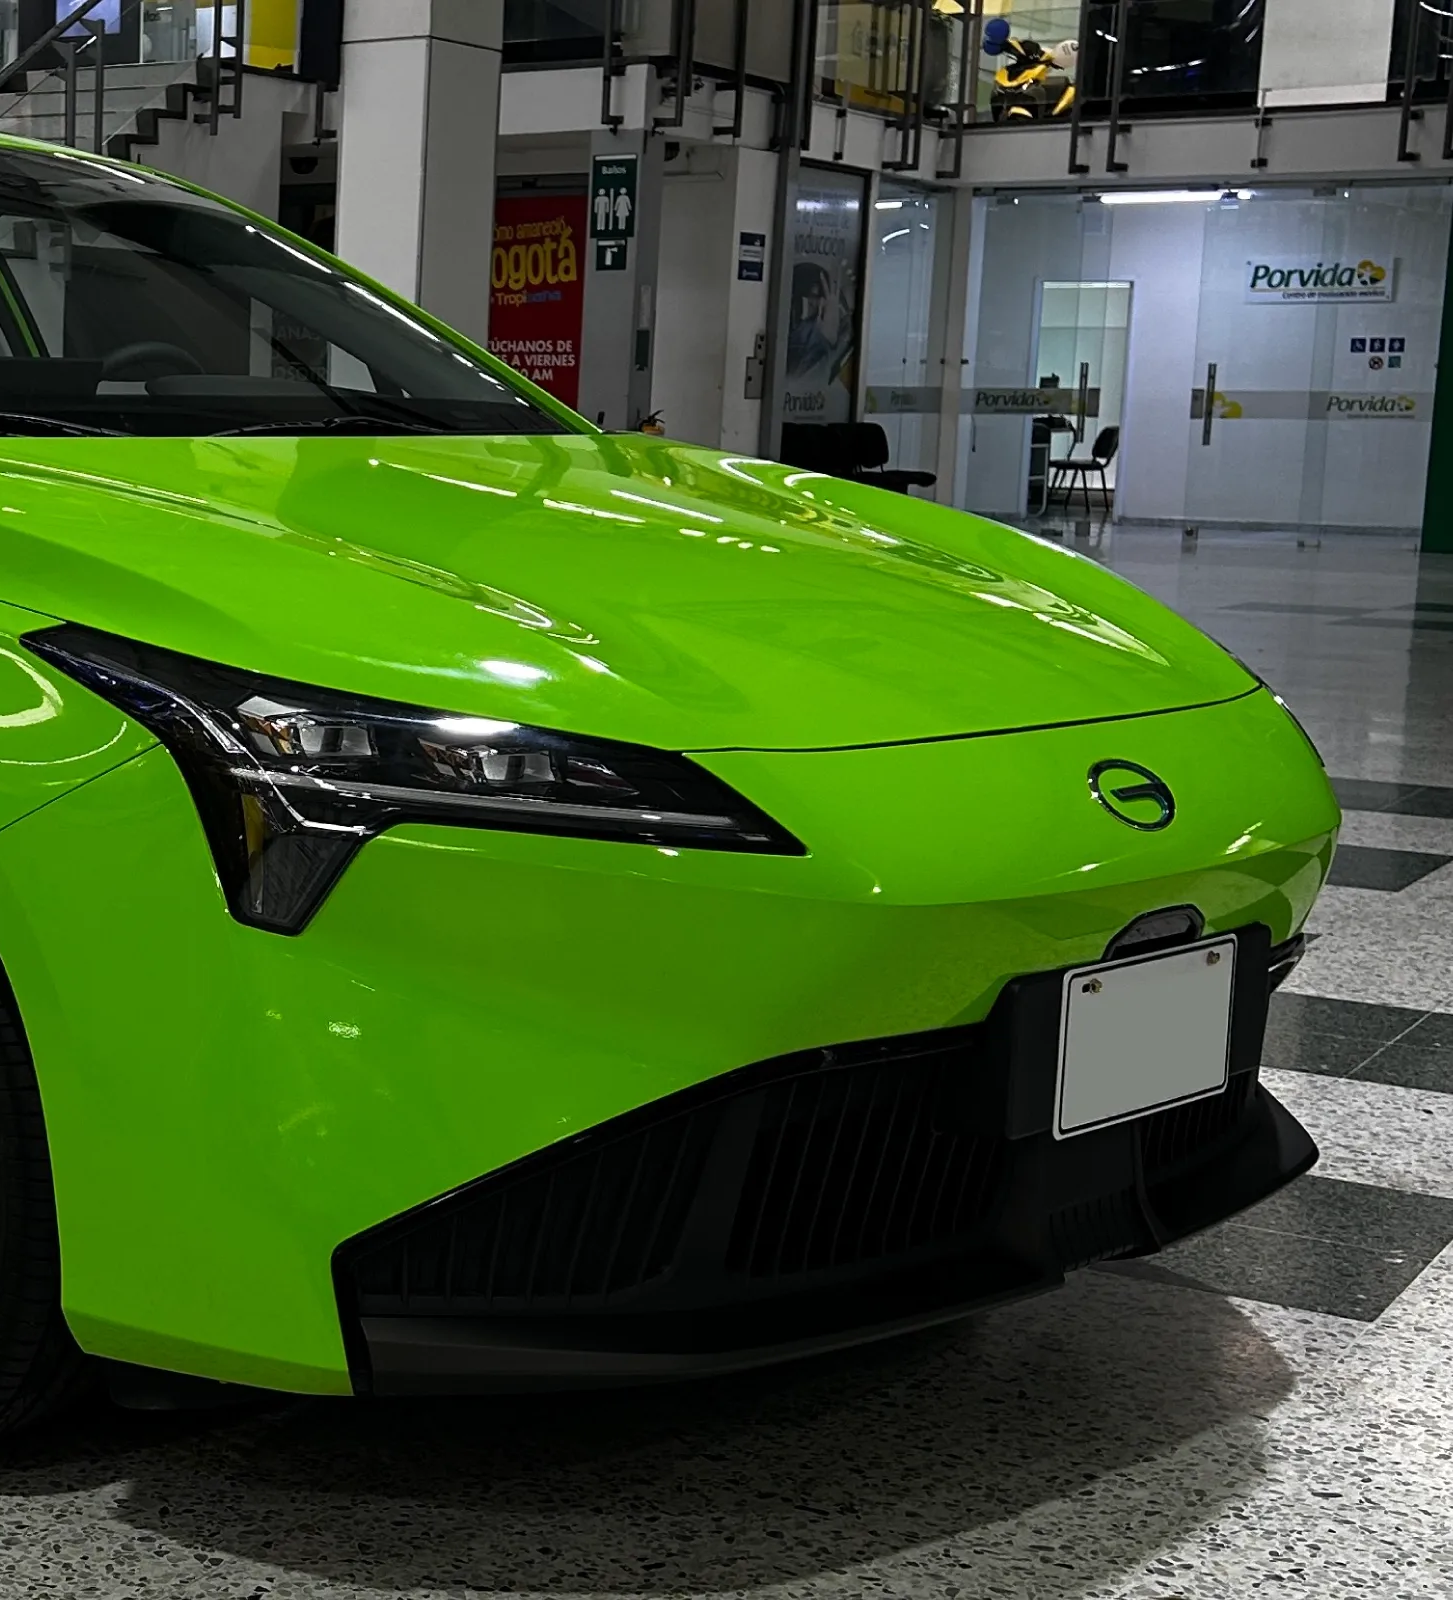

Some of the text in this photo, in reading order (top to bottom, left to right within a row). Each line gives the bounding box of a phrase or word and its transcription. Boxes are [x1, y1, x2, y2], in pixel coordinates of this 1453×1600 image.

[492, 223, 514, 241] ómo
[492, 226, 577, 291] ogotá
[1250, 262, 1356, 289] Porvida
[488, 337, 573, 353] ÚCHANOS DE
[510, 354, 522, 367] A
[524, 354, 576, 367] VIERNES
[532, 368, 554, 381] AM
[975, 390, 1038, 408] Porvida
[1326, 395, 1397, 412] Porvida
